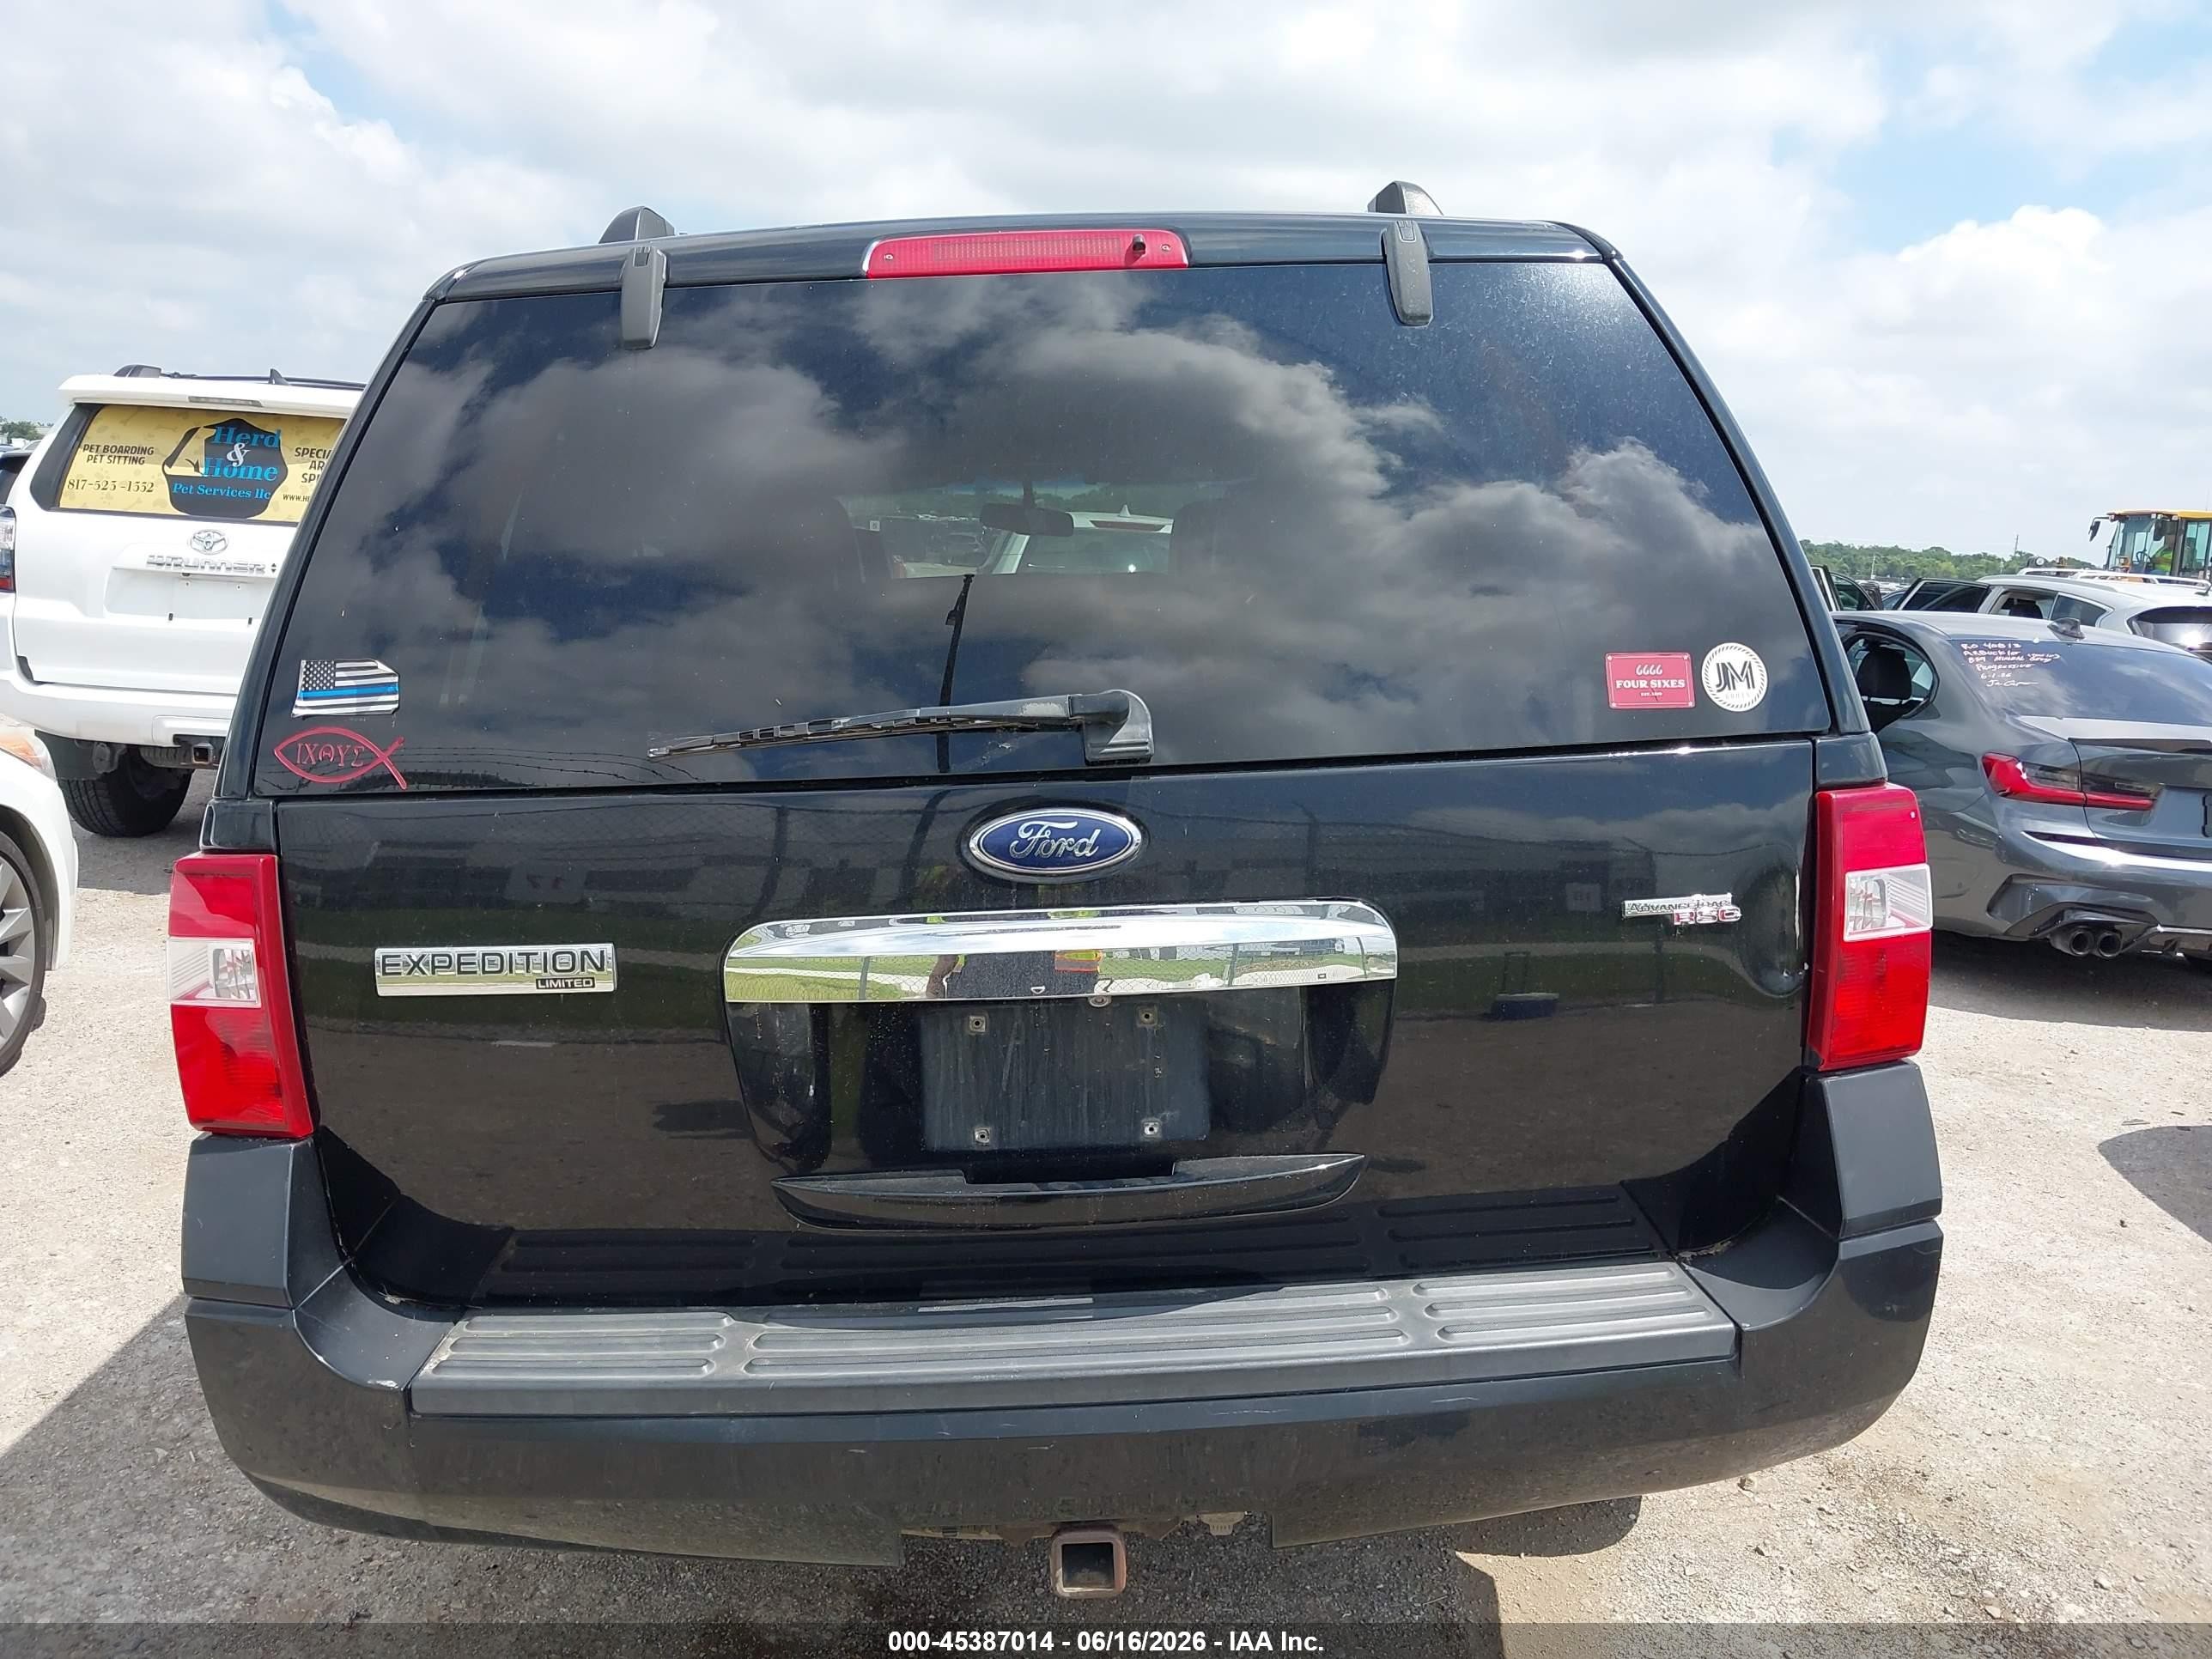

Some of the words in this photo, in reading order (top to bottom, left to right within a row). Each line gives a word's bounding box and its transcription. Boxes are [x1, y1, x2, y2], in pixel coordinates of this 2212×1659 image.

[211, 426, 282, 447] Herd
[82, 444, 101, 453] PET
[103, 445, 155, 455] BOARDING
[226, 442, 251, 467] &
[87, 455, 104, 464] PET
[106, 455, 146, 465] SITTING
[202, 457, 278, 481] Home
[173, 483, 193, 494] Pet
[197, 484, 252, 498] Services
[1636, 665, 1662, 675] 6666
[1714, 660, 1755, 692] JM
[1615, 679, 1649, 689] FOUR
[1650, 679, 1686, 688] SIXES
[1009, 820, 1102, 859] Ford
[380, 948, 607, 976] EXPEDITION
[536, 977, 594, 989] LIMITED
